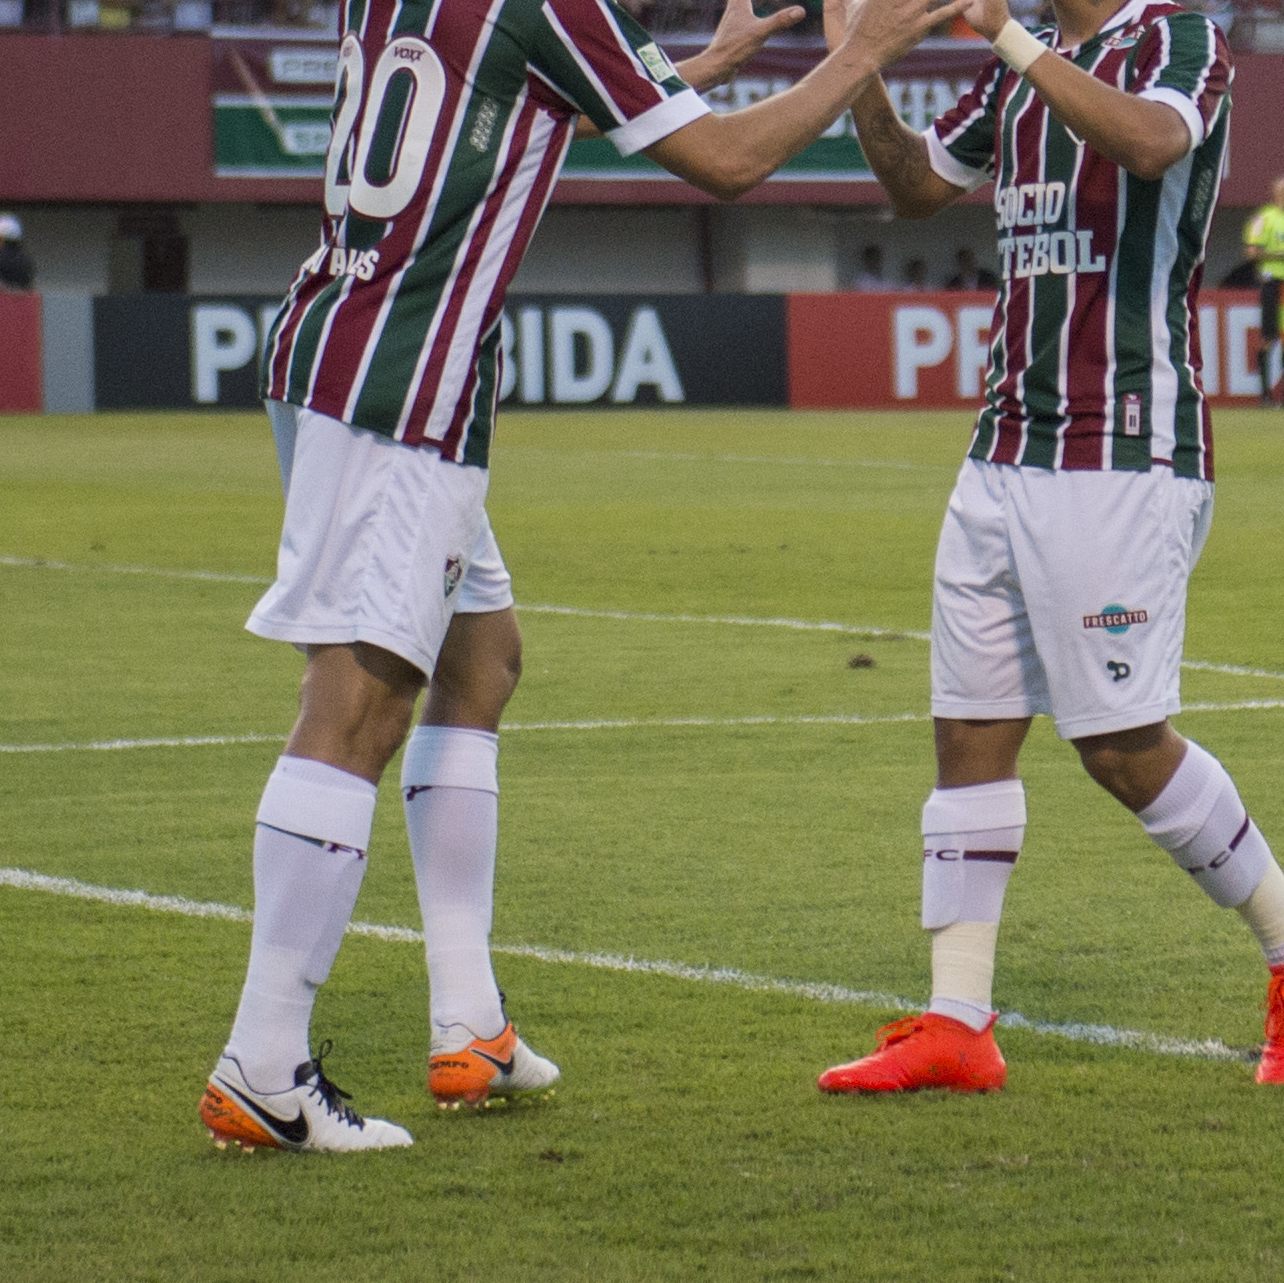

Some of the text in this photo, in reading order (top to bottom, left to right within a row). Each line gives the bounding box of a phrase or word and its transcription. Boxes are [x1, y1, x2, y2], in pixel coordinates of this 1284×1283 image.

[325, 35, 446, 218] 20
[192, 305, 685, 404] PIDA
[1084, 611, 1147, 628] FRESCATTO
